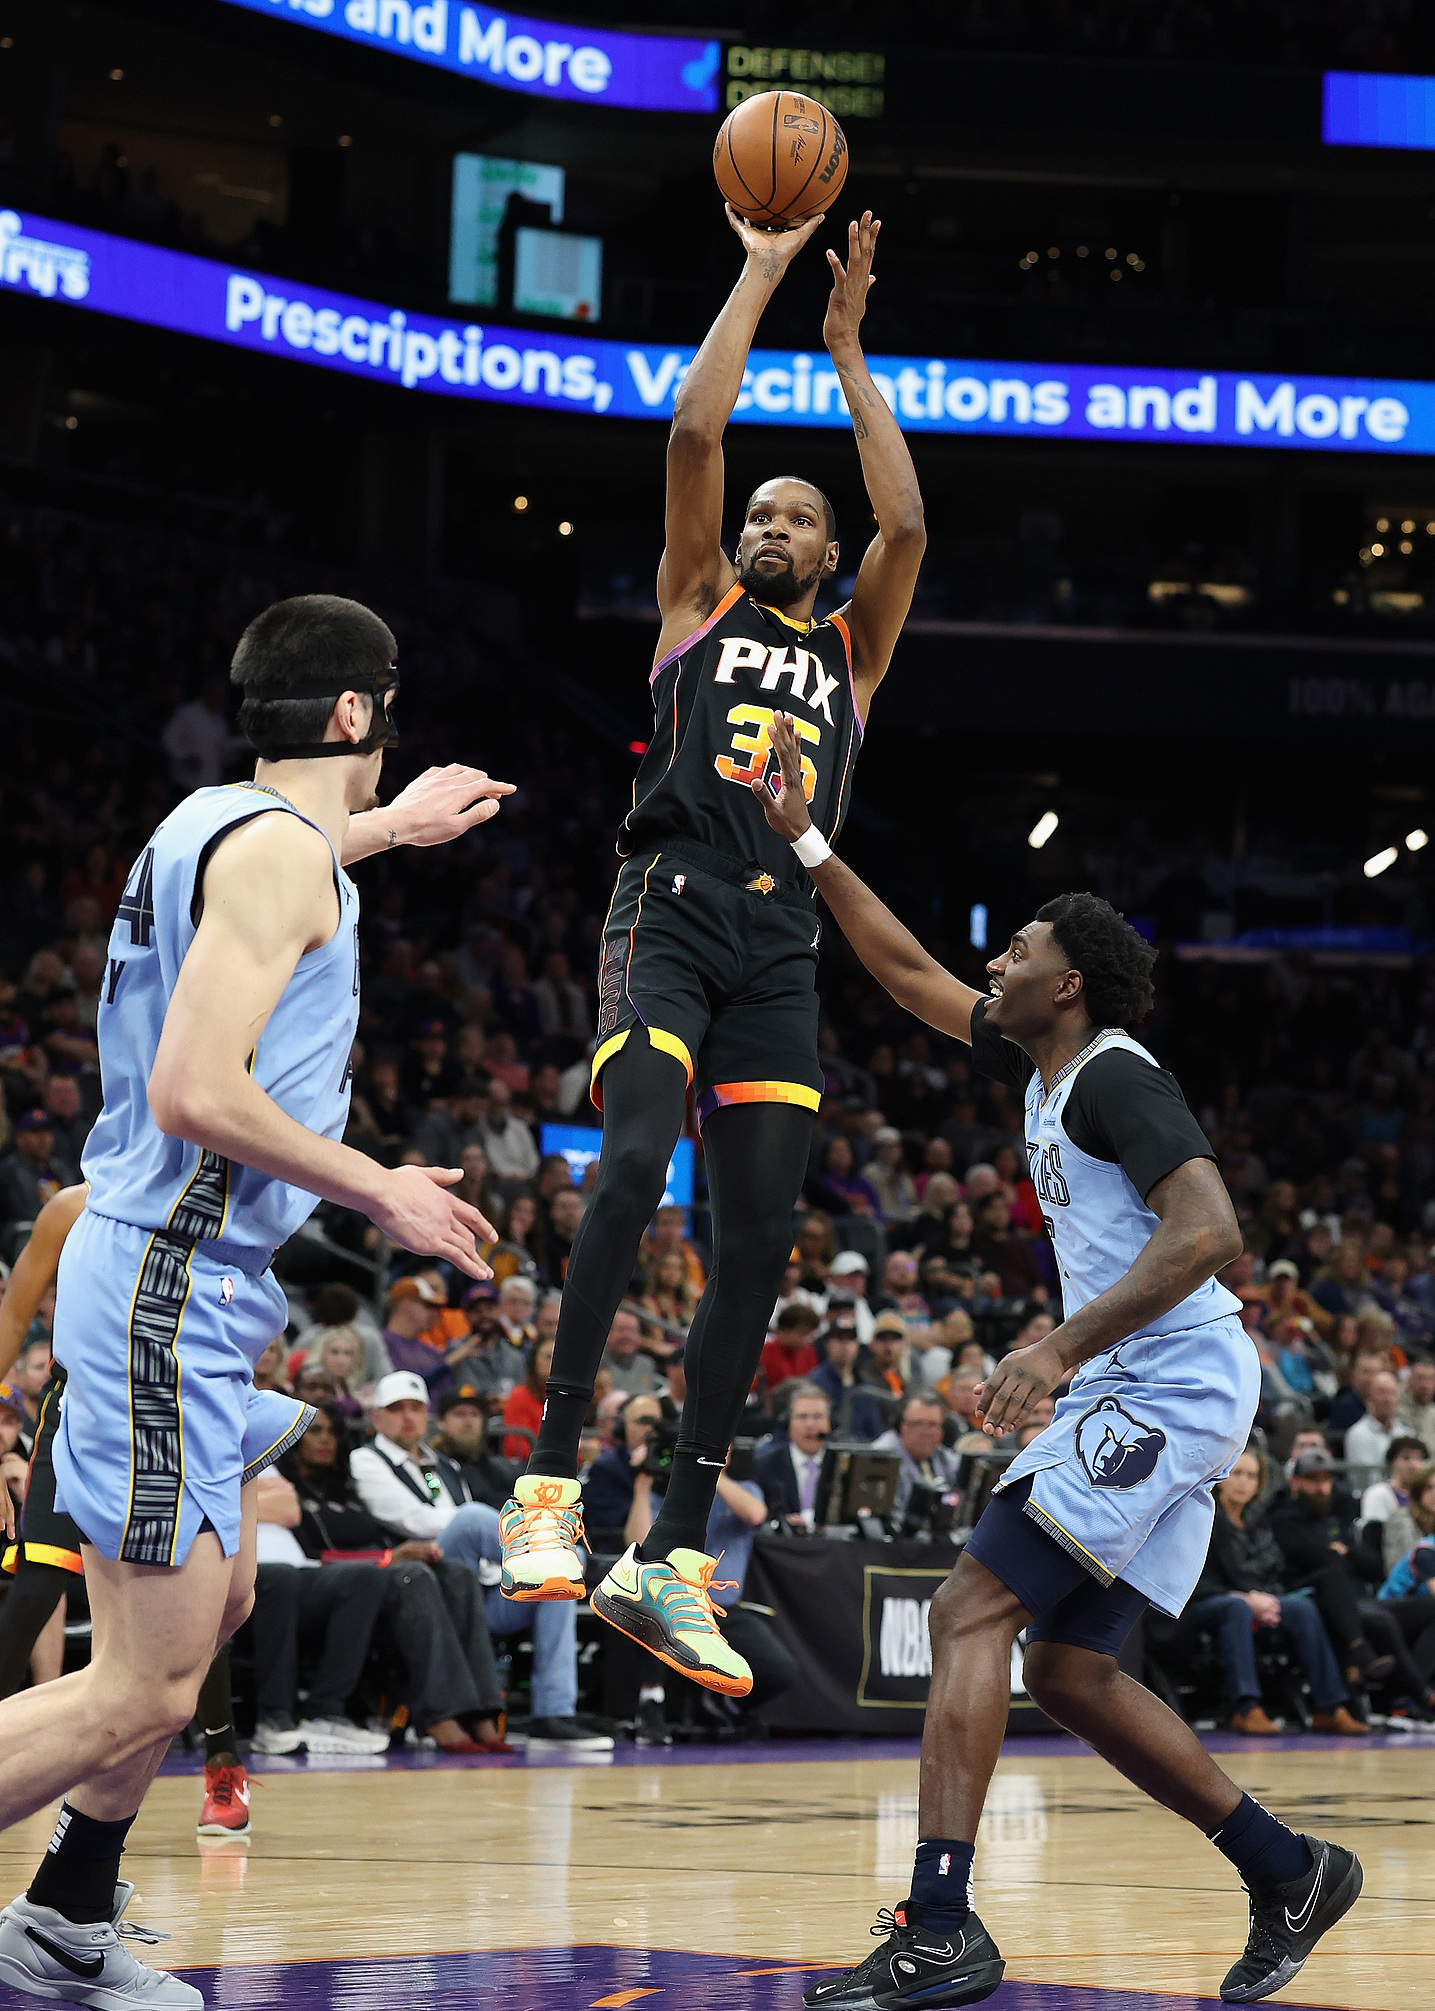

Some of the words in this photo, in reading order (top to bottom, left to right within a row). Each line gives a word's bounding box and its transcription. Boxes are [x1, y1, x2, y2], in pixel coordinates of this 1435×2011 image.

[344, 0, 448, 54] and
[458, 8, 613, 94] More
[727, 46, 886, 84] DEFENSE!
[726, 80, 885, 118] DNSE!
[225, 273, 613, 413] Prescriptions,
[626, 353, 1070, 425] Vcintions
[1085, 375, 1218, 433] and
[1235, 379, 1410, 443] More
[713, 637, 840, 728] PHX
[714, 703, 821, 805] 35
